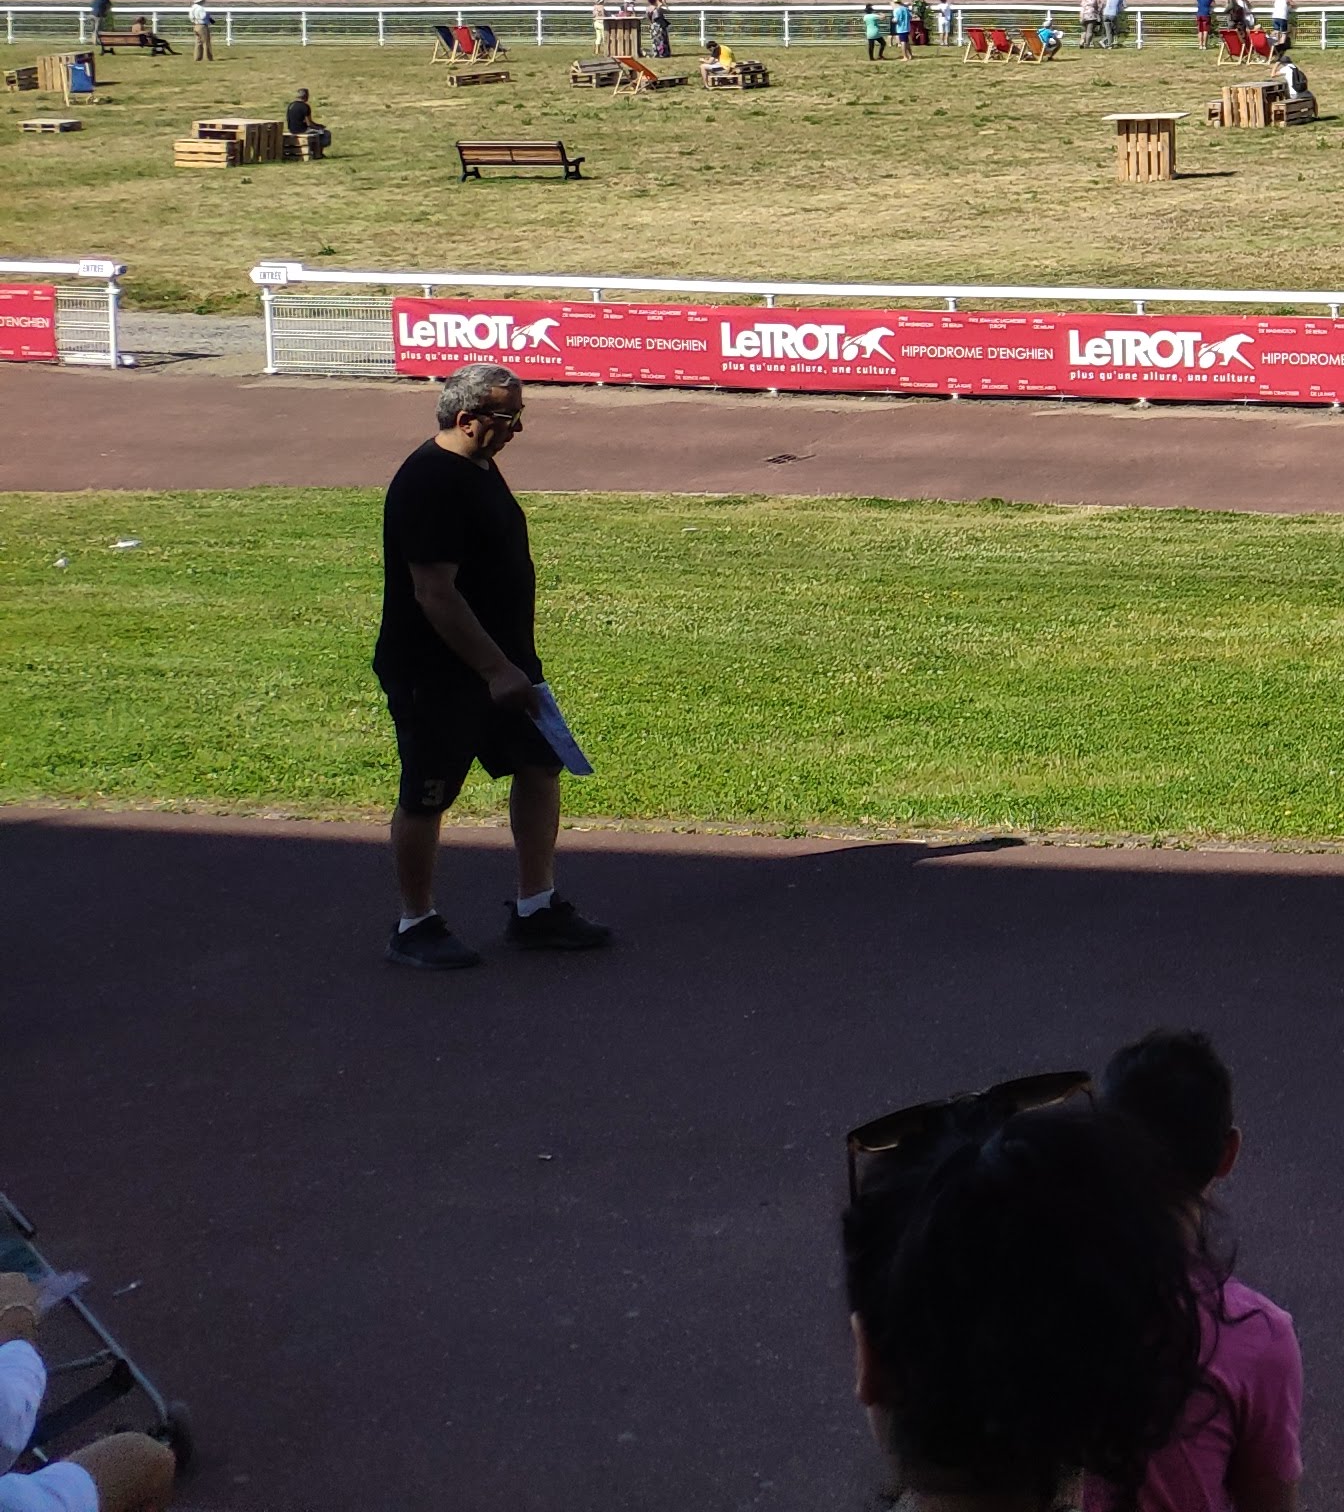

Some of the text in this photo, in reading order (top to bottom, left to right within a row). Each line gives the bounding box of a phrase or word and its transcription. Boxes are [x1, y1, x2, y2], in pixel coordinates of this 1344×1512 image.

[398, 313, 513, 349] LeTROT
[566, 335, 707, 351] HIPPODROME D'ENGHIEN
[720, 322, 845, 360] LeTROT
[901, 345, 1054, 360] HIPPODROME D'ENGHIEN
[1068, 330, 1201, 368] LeTROT
[400, 351, 422, 362] plus
[502, 355, 521, 363] une
[524, 354, 562, 364] culture
[722, 361, 745, 372] plus
[832, 366, 851, 374] une
[856, 365, 897, 375] culture
[1070, 370, 1095, 382] plus
[1187, 374, 1208, 382] une
[1213, 373, 1256, 383] culture
